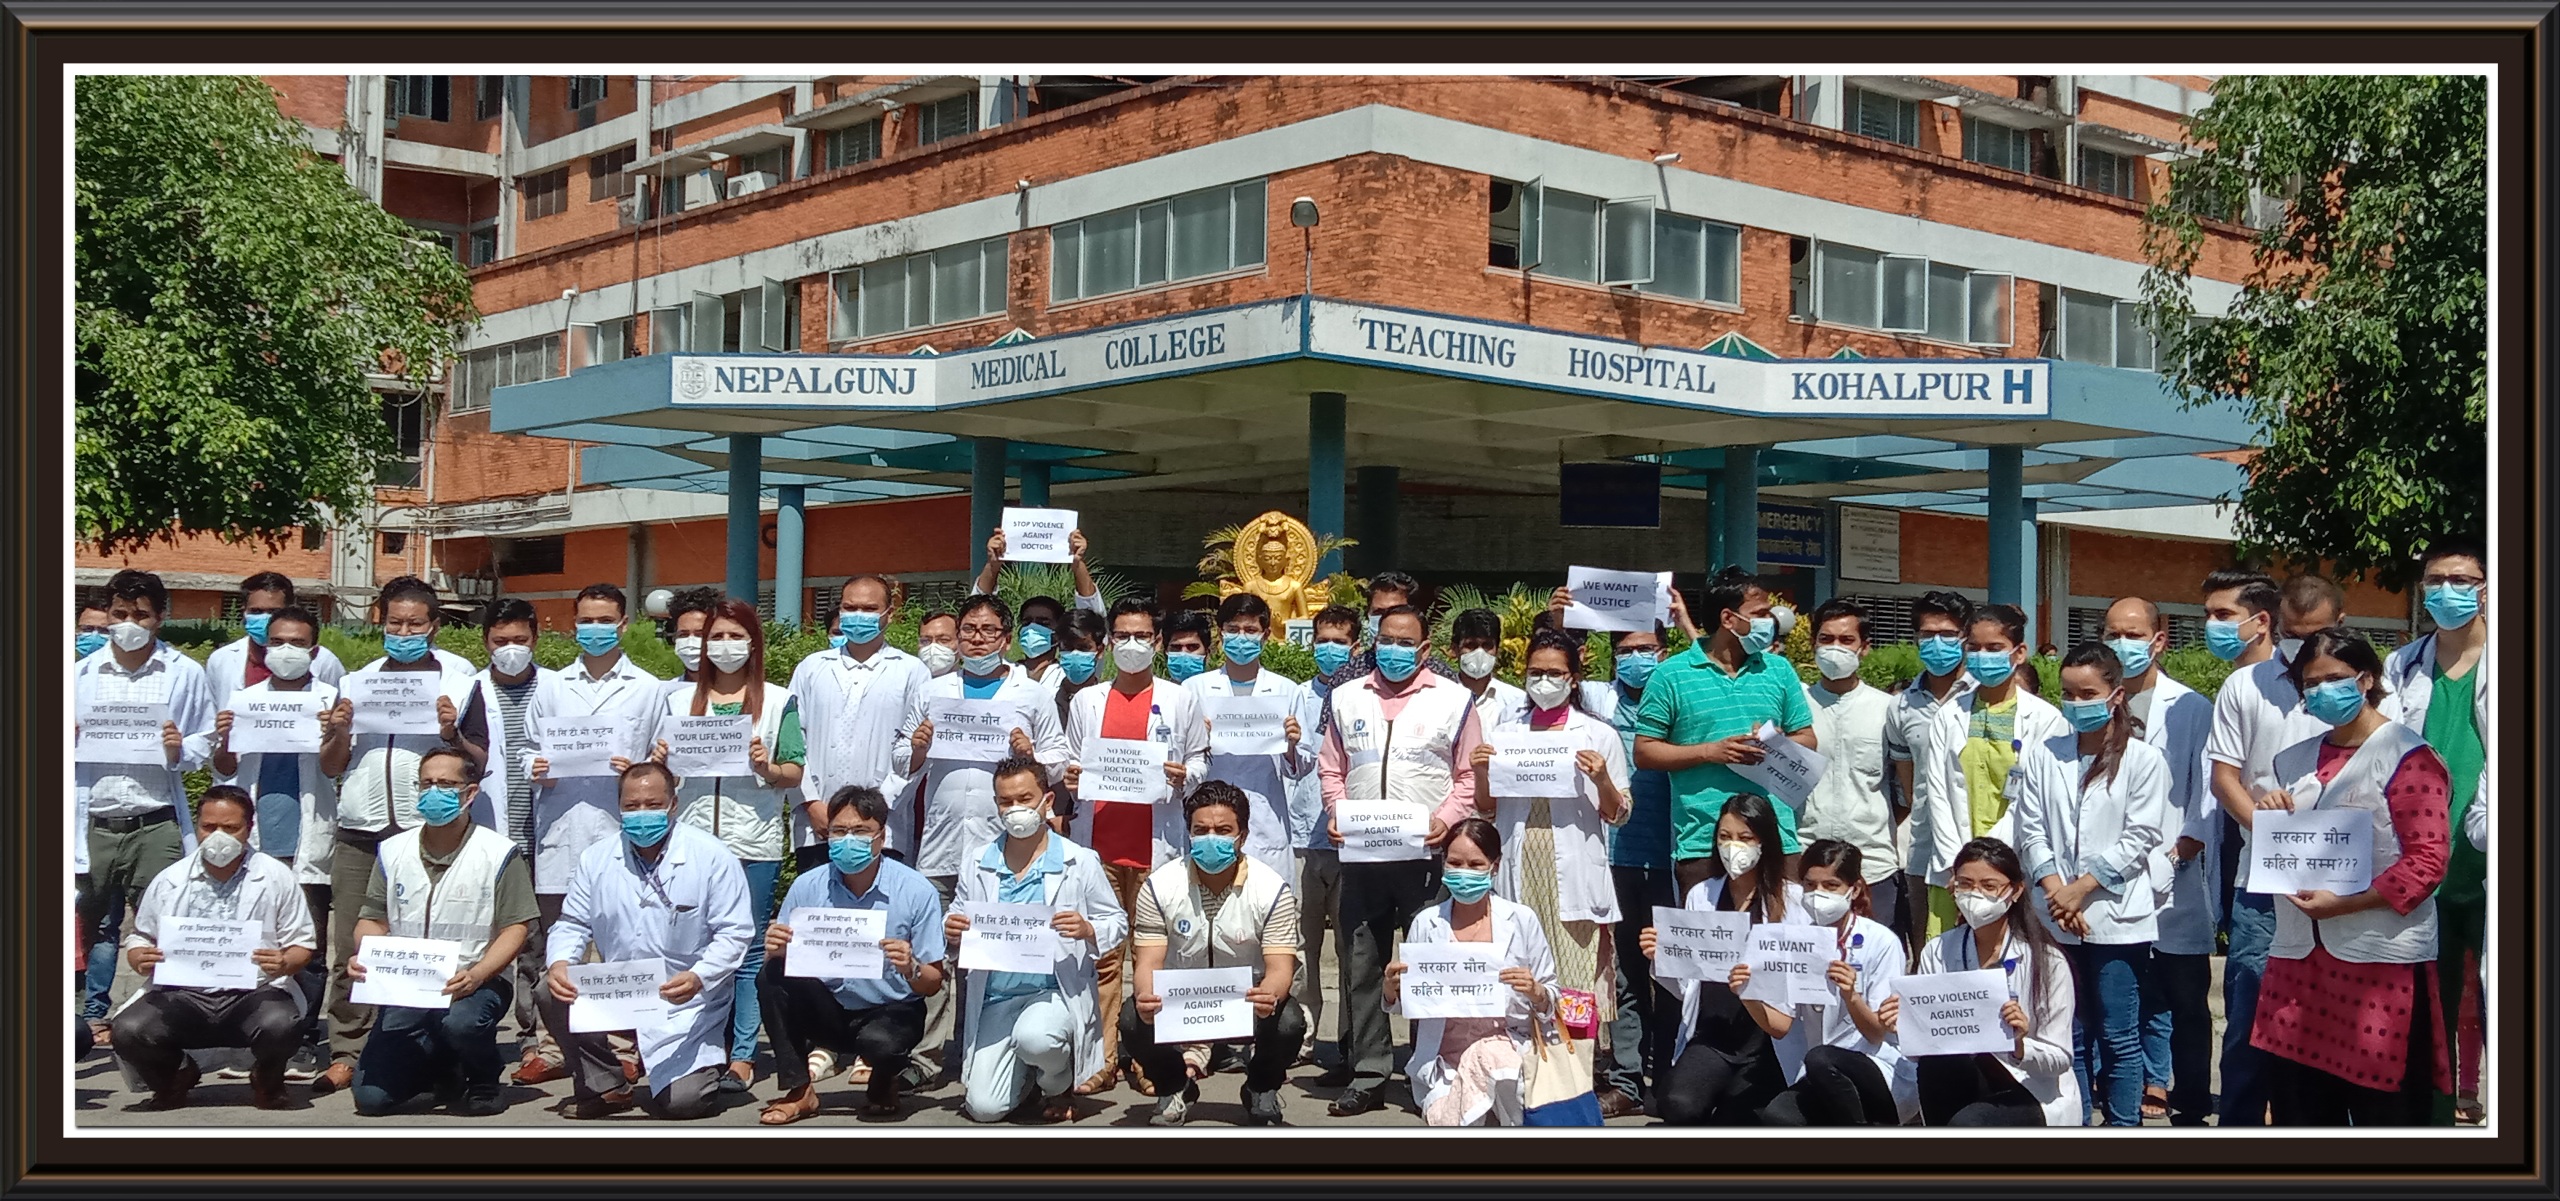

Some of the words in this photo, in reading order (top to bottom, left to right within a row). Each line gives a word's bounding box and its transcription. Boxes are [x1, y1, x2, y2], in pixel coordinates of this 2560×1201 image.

[714, 366, 917, 395] NEPALGUNJ
[971, 349, 1067, 390] MEDICAL
[1105, 323, 1226, 369] COLLEGE
[1359, 317, 1517, 368] TEACHING
[1568, 347, 1716, 395] HOSPITAL
[1792, 372, 1992, 401] KOHALPUR
[2003, 369, 2032, 404] H
[1757, 512, 1821, 532] MERGENCY
[1583, 581, 1600, 590] WE
[1603, 582, 1638, 592] WANT
[1589, 597, 1631, 607] JUSTICE
[92, 705, 107, 713] WE
[249, 703, 266, 711] WE
[269, 704, 303, 712] WANT
[111, 719, 131, 728] LIFE,
[254, 720, 295, 728] JUSTICE
[943, 713, 975, 724] सरकार
[981, 712, 1000, 725] मौन
[127, 732, 139, 740] US
[936, 729, 964, 742] कहिले
[676, 746, 712, 754] PROTECT
[715, 745, 726, 753] US
[1528, 747, 1568, 755] VIOLENCE
[1098, 756, 1137, 764] VIOLENCE
[1789, 760, 1809, 776] मौन
[1102, 775, 1135, 783] ENOUGH
[1516, 774, 1557, 782] DOCTORS
[1350, 814, 1371, 822] STOP
[1373, 813, 1413, 821] VIOLENCE
[1364, 826, 1400, 834] AGAINST
[2271, 831, 2317, 844] सरकार
[2323, 827, 2351, 845] मौन
[1364, 839, 1403, 847] DOCTORS
[2262, 853, 2299, 871] कहिले
[1006, 930, 1022, 942] किन
[1025, 934, 1037, 942] ???
[1669, 926, 1705, 939] सरकार
[1710, 925, 1734, 941] मौन
[1759, 940, 1776, 951] WE
[1778, 940, 1815, 953] WANT
[1663, 945, 1693, 960] कहिले
[1418, 962, 1457, 973] सरकार
[1463, 957, 1486, 973] मौन
[1763, 963, 1808, 973] JUSTICE
[615, 989, 632, 1000] किन
[636, 989, 649, 997] ???
[1168, 987, 1191, 997] STOP
[1193, 985, 1236, 996] VIOLENCE
[1411, 981, 1443, 997] कहिले
[1910, 995, 1936, 1005] STOP
[1938, 990, 1989, 1003] VIOLENCE
[1184, 1000, 1223, 1010] AGAINST
[1183, 1014, 1225, 1025] DOCTORS
[1930, 1008, 1975, 1020] AGAINST
[1931, 1025, 1980, 1037] DOCTORS
